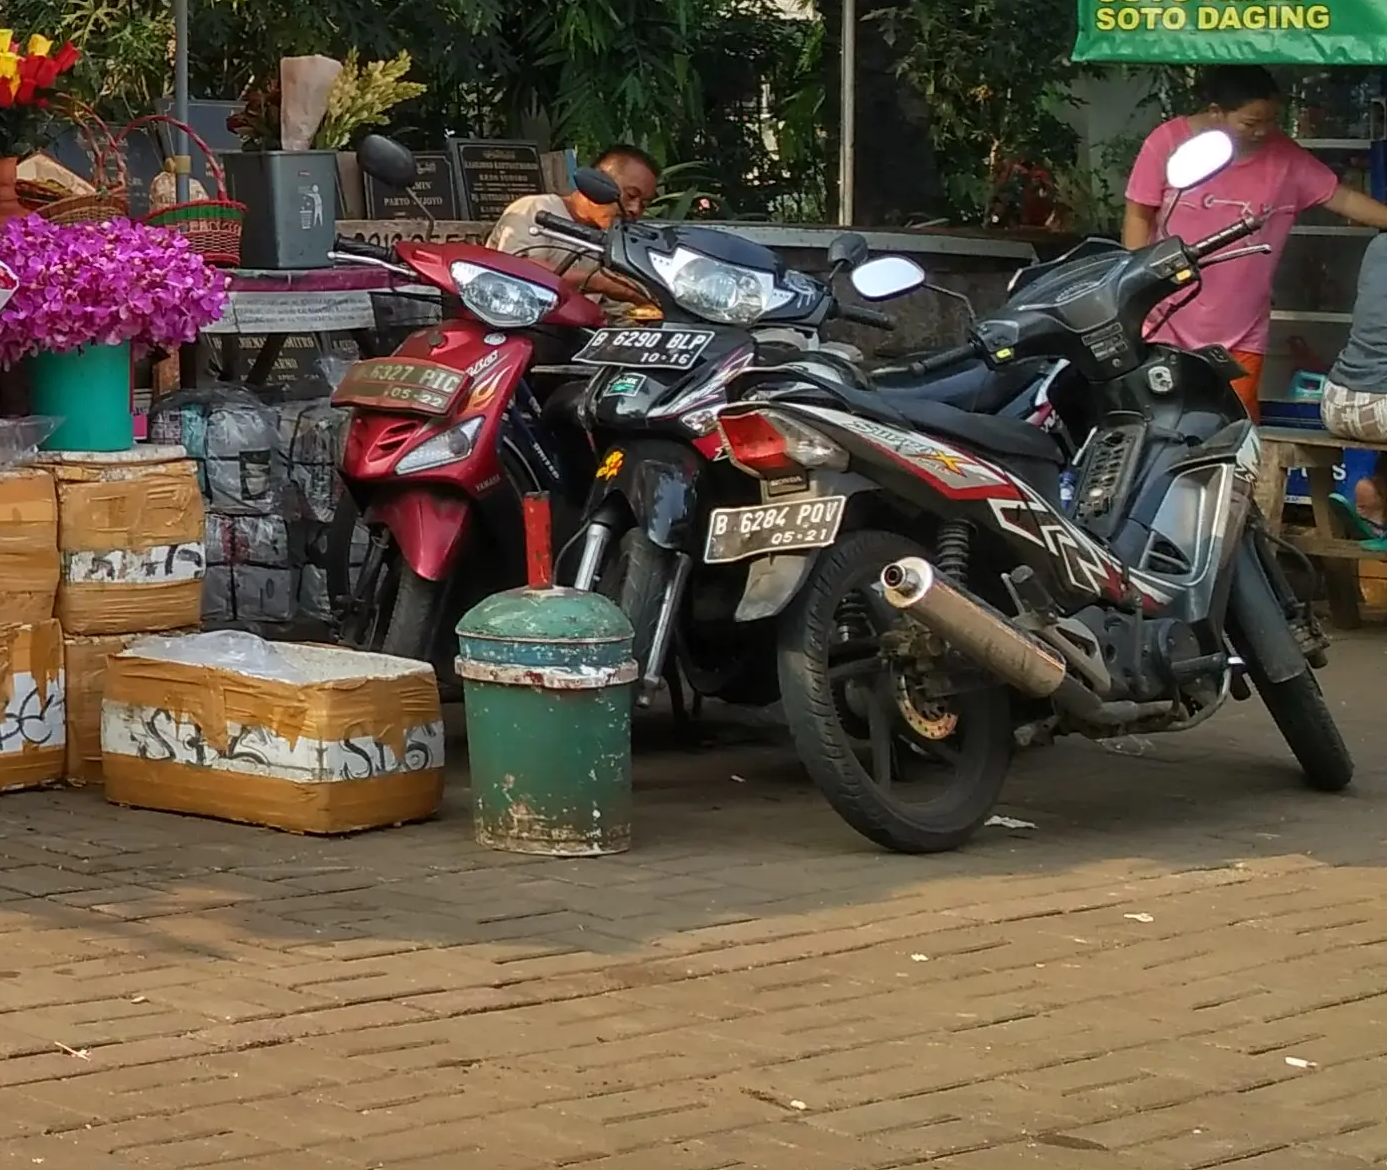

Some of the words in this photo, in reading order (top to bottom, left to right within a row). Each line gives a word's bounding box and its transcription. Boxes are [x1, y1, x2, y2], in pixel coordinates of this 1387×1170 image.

[1095, 7, 1186, 31] SOTO
[1197, 5, 1330, 30] DAGING
[592, 332, 609, 347] B
[612, 332, 662, 348] 6290
[666, 333, 707, 350] BLP
[370, 365, 414, 381] 6327
[418, 370, 463, 393] PIC
[770, 475, 803, 487] HONDA
[715, 515, 728, 535] B
[740, 507, 789, 534] 6284
